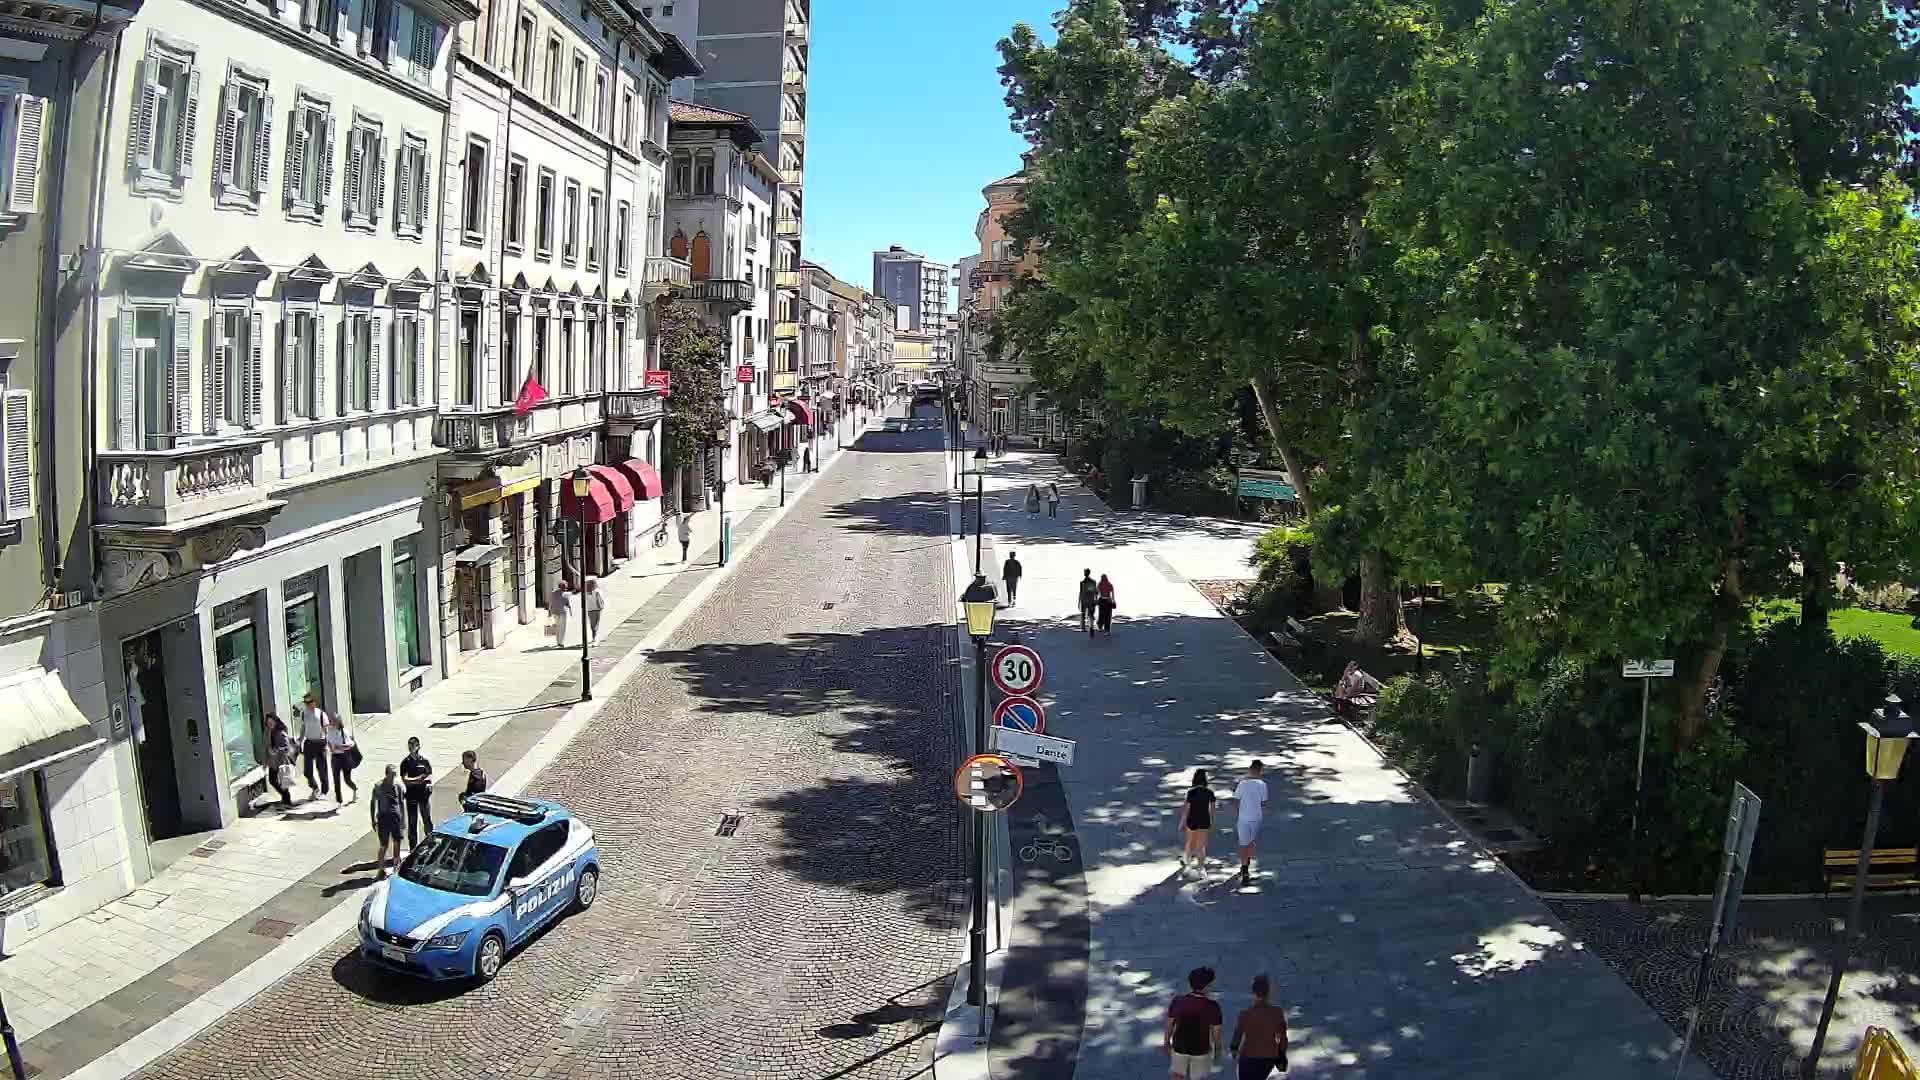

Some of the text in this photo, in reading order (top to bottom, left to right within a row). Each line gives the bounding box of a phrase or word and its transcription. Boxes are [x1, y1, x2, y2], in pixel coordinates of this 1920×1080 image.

[1004, 659, 1032, 682] 30
[1036, 745, 1067, 760] Dante
[516, 868, 575, 920] POLIZIA
